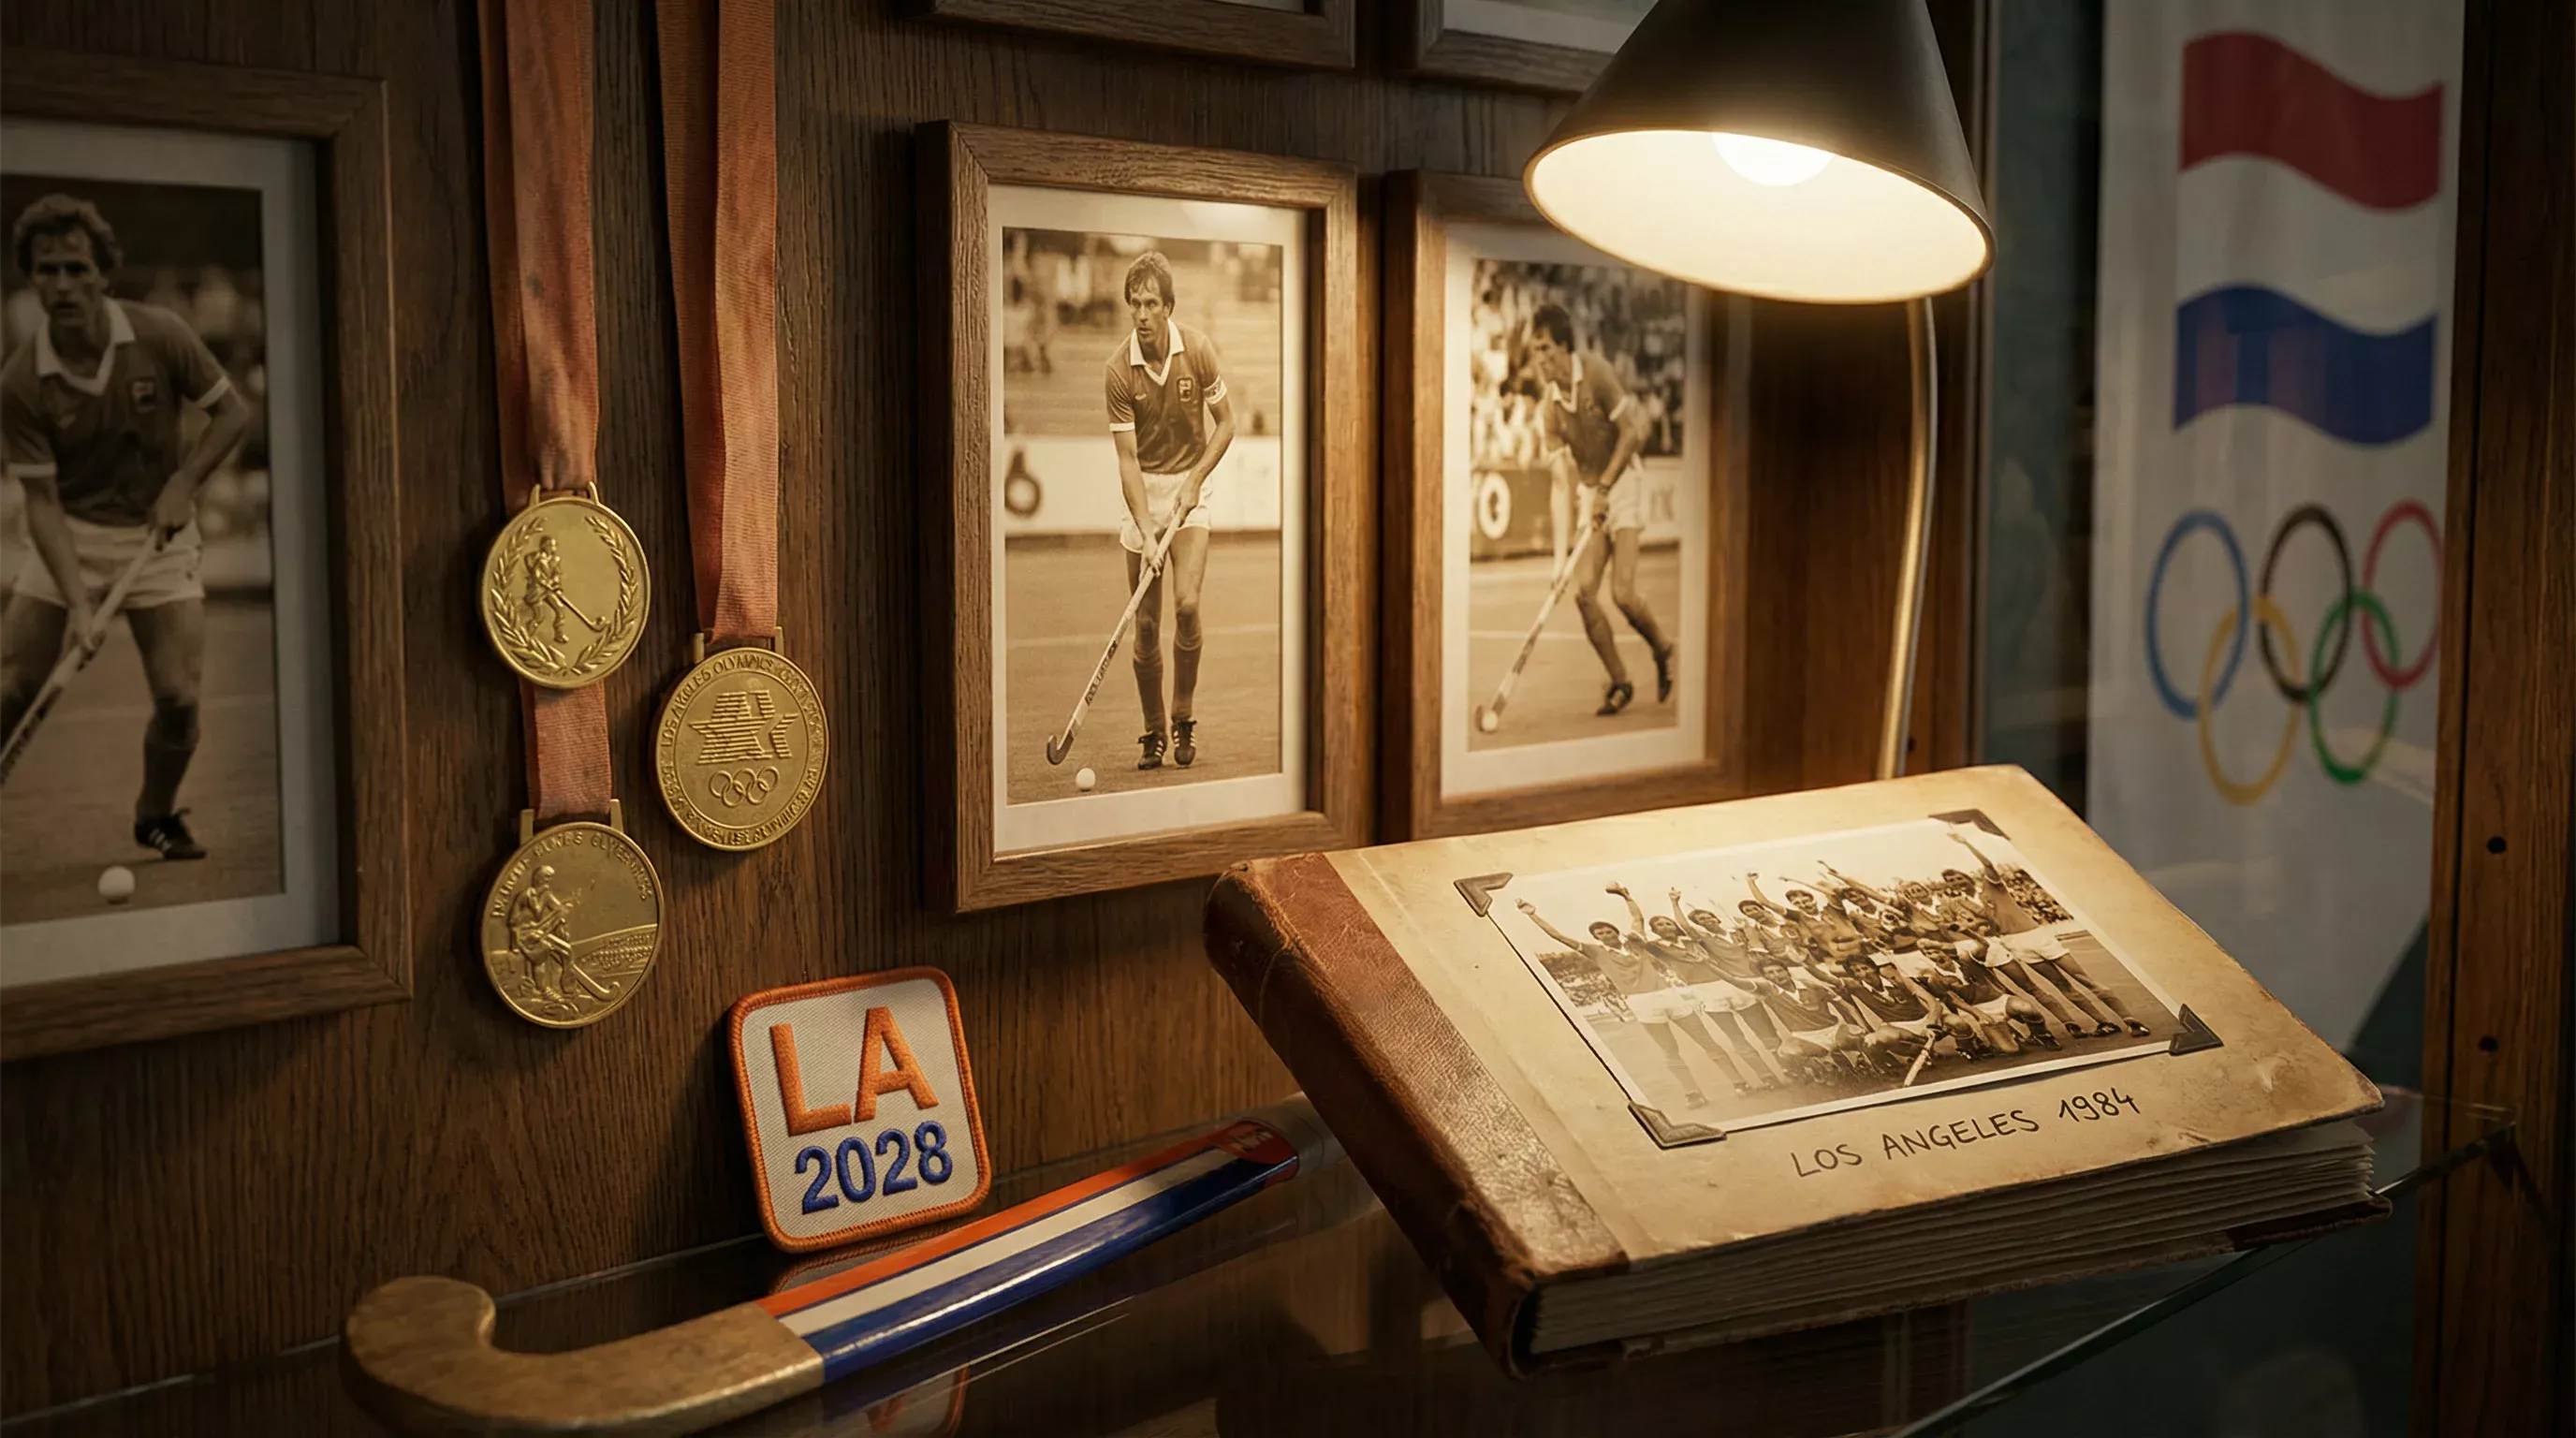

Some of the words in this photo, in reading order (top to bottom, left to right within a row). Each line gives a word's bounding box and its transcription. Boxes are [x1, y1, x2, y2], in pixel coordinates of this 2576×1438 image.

[770, 1005, 939, 1137] LA
[795, 1120, 953, 1215] 2028
[1790, 1144, 1863, 1178] LOS
[1881, 1109, 2040, 1160] ANGELES
[2057, 1087, 2142, 1123] 1984
